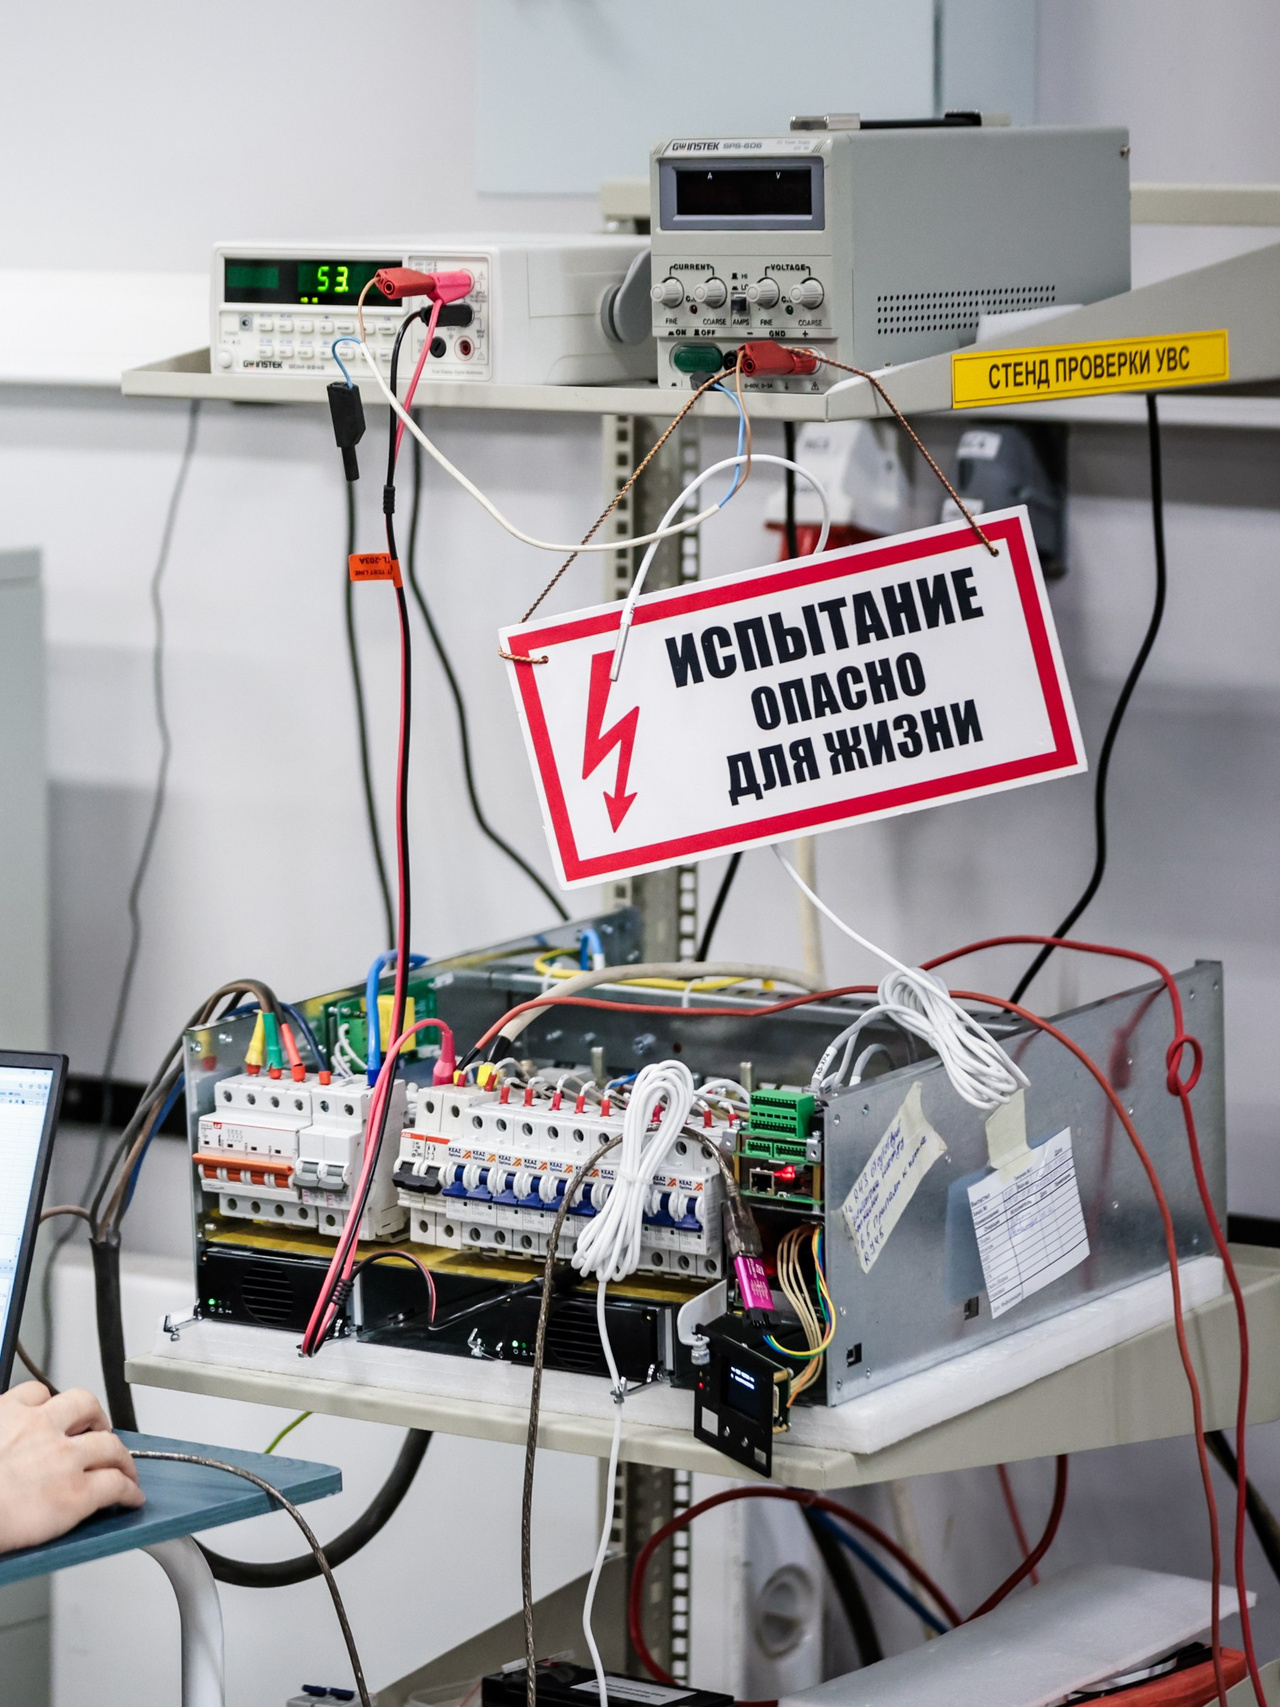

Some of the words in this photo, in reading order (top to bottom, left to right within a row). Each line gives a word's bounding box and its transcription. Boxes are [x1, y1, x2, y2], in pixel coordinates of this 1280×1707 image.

[989, 359, 1050, 389] СТЕНД
[1055, 350, 1150, 383] ПРОВЕРКИ
[1155, 345, 1190, 373] УВС
[665, 567, 984, 688] ИСПЫТАНИЕ
[751, 652, 926, 731] ОПАСНО
[726, 737, 821, 806] ДЛЯ
[823, 699, 984, 776] ЖИЗНИ
